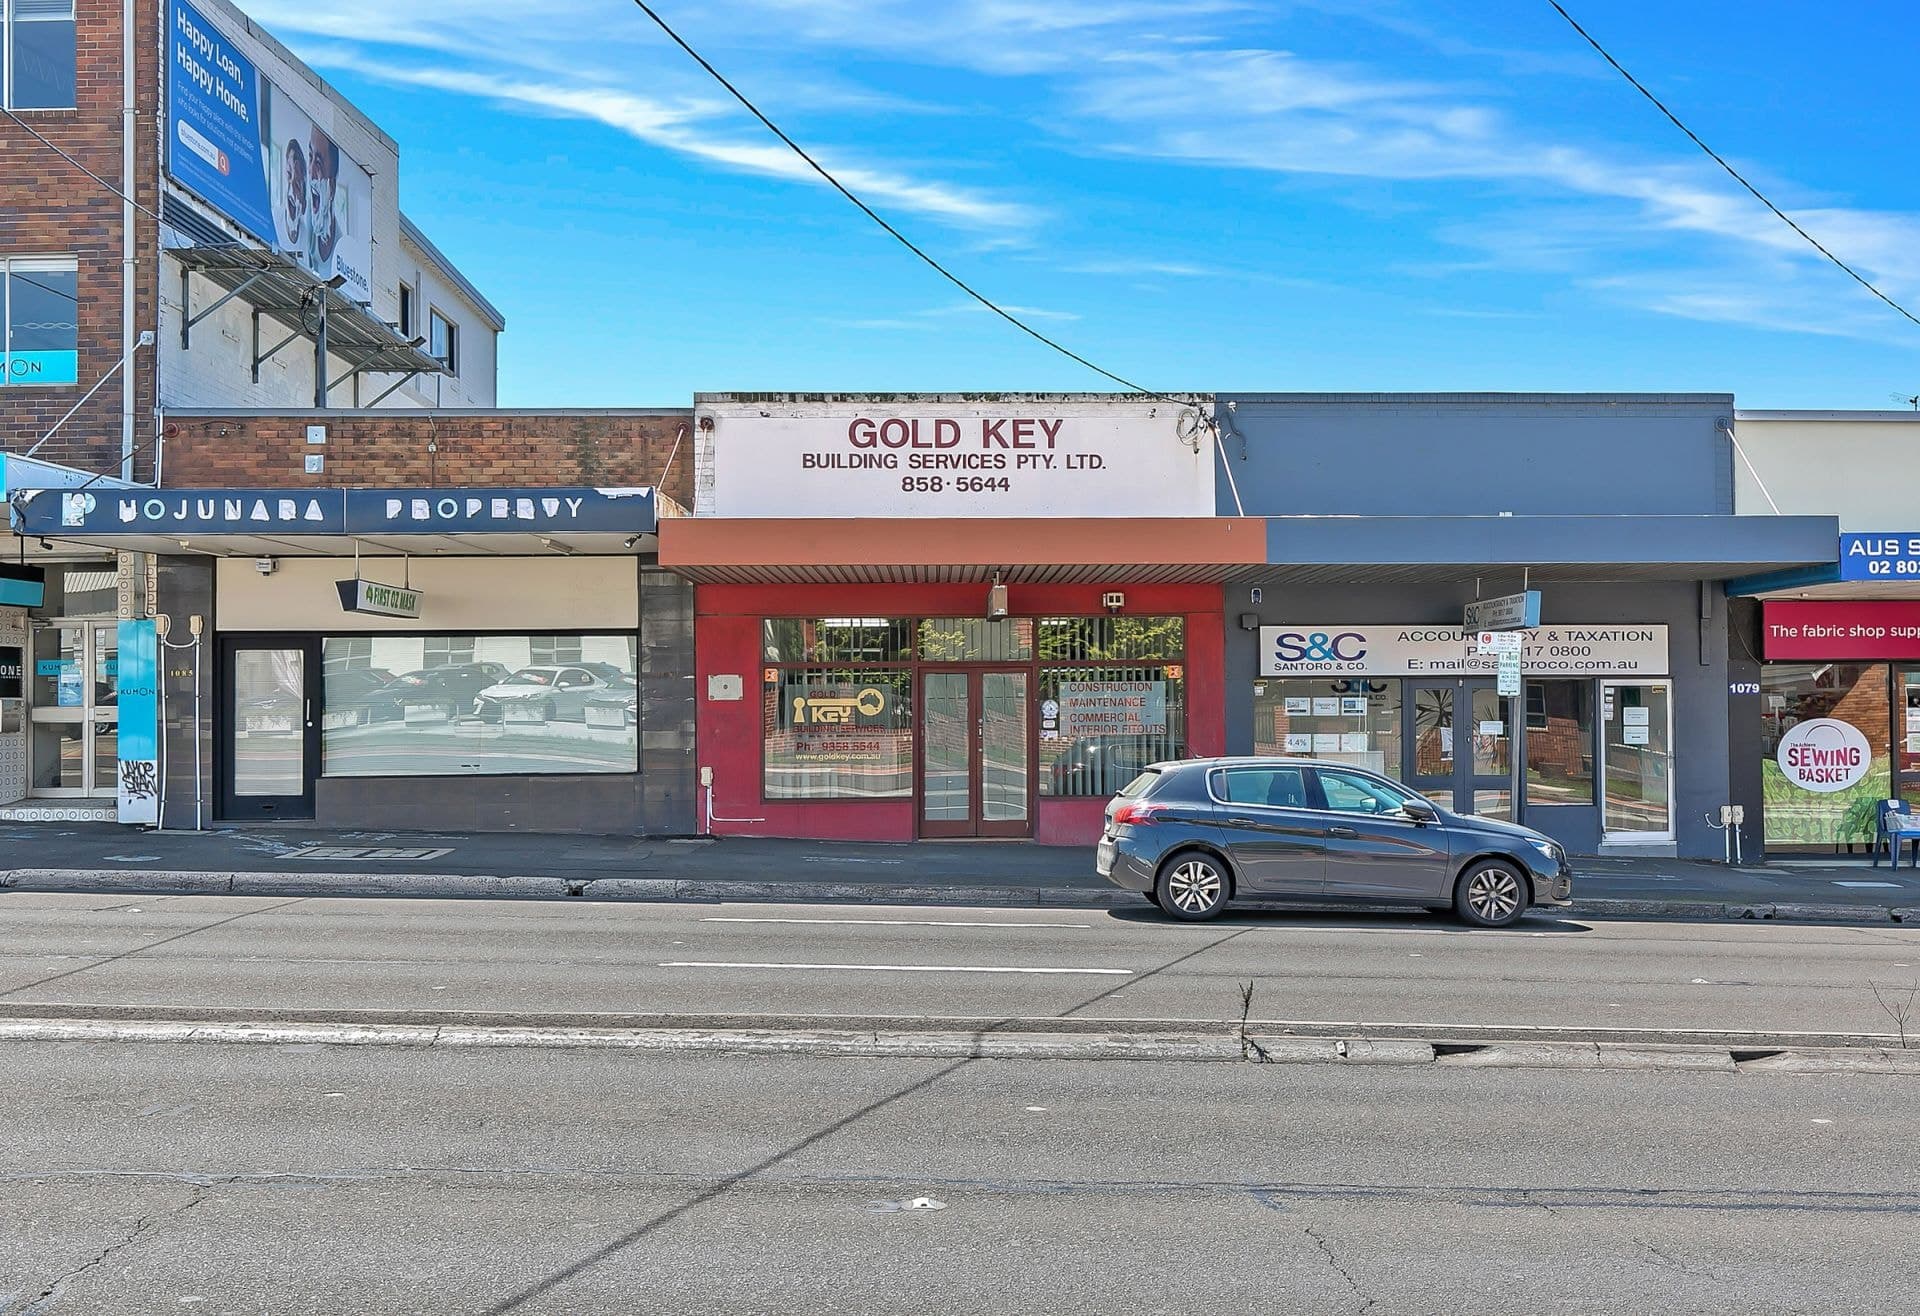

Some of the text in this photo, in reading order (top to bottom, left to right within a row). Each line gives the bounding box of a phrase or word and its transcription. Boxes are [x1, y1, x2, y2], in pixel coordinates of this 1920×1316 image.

[178, 8, 243, 90] Happy Loan,
[178, 42, 249, 123] Happy Home.
[337, 255, 368, 292] Bluestone.
[848, 418, 1064, 449] GOLD KEY
[802, 453, 1107, 469] BUILDING SERVICES PTY. LTD.
[1849, 539, 1899, 556] AUS
[1868, 560, 1920, 574] 02 80
[374, 586, 390, 606] FIRST
[400, 591, 416, 611] MASK
[1547, 631, 1559, 642] &
[1565, 631, 1653, 642] TAXATION
[1771, 624, 1920, 639] The fabric shop sup
[1275, 632, 1367, 662] S&C
[1550, 646, 1591, 657] 0800
[1274, 663, 1368, 671] SANTORO & CO.
[1407, 659, 1423, 669] E:
[120, 687, 154, 696] KUMON
[1069, 682, 1152, 692] CONSTRUCTION
[1729, 683, 1760, 693] 1079
[810, 690, 836, 698] GOLD
[1069, 698, 1146, 707] MAINTENANCE
[812, 706, 851, 723] KEY
[1069, 713, 1140, 722] COMMERCIAL
[793, 725, 886, 733] BUILDING SERVICES
[1069, 725, 1166, 734] INTERIOR FITOUTS
[796, 742, 814, 751] Ph:
[795, 752, 881, 761] www.goldkey.com.au
[1788, 747, 1860, 766] SEWING
[1799, 768, 1851, 783] BASKET
